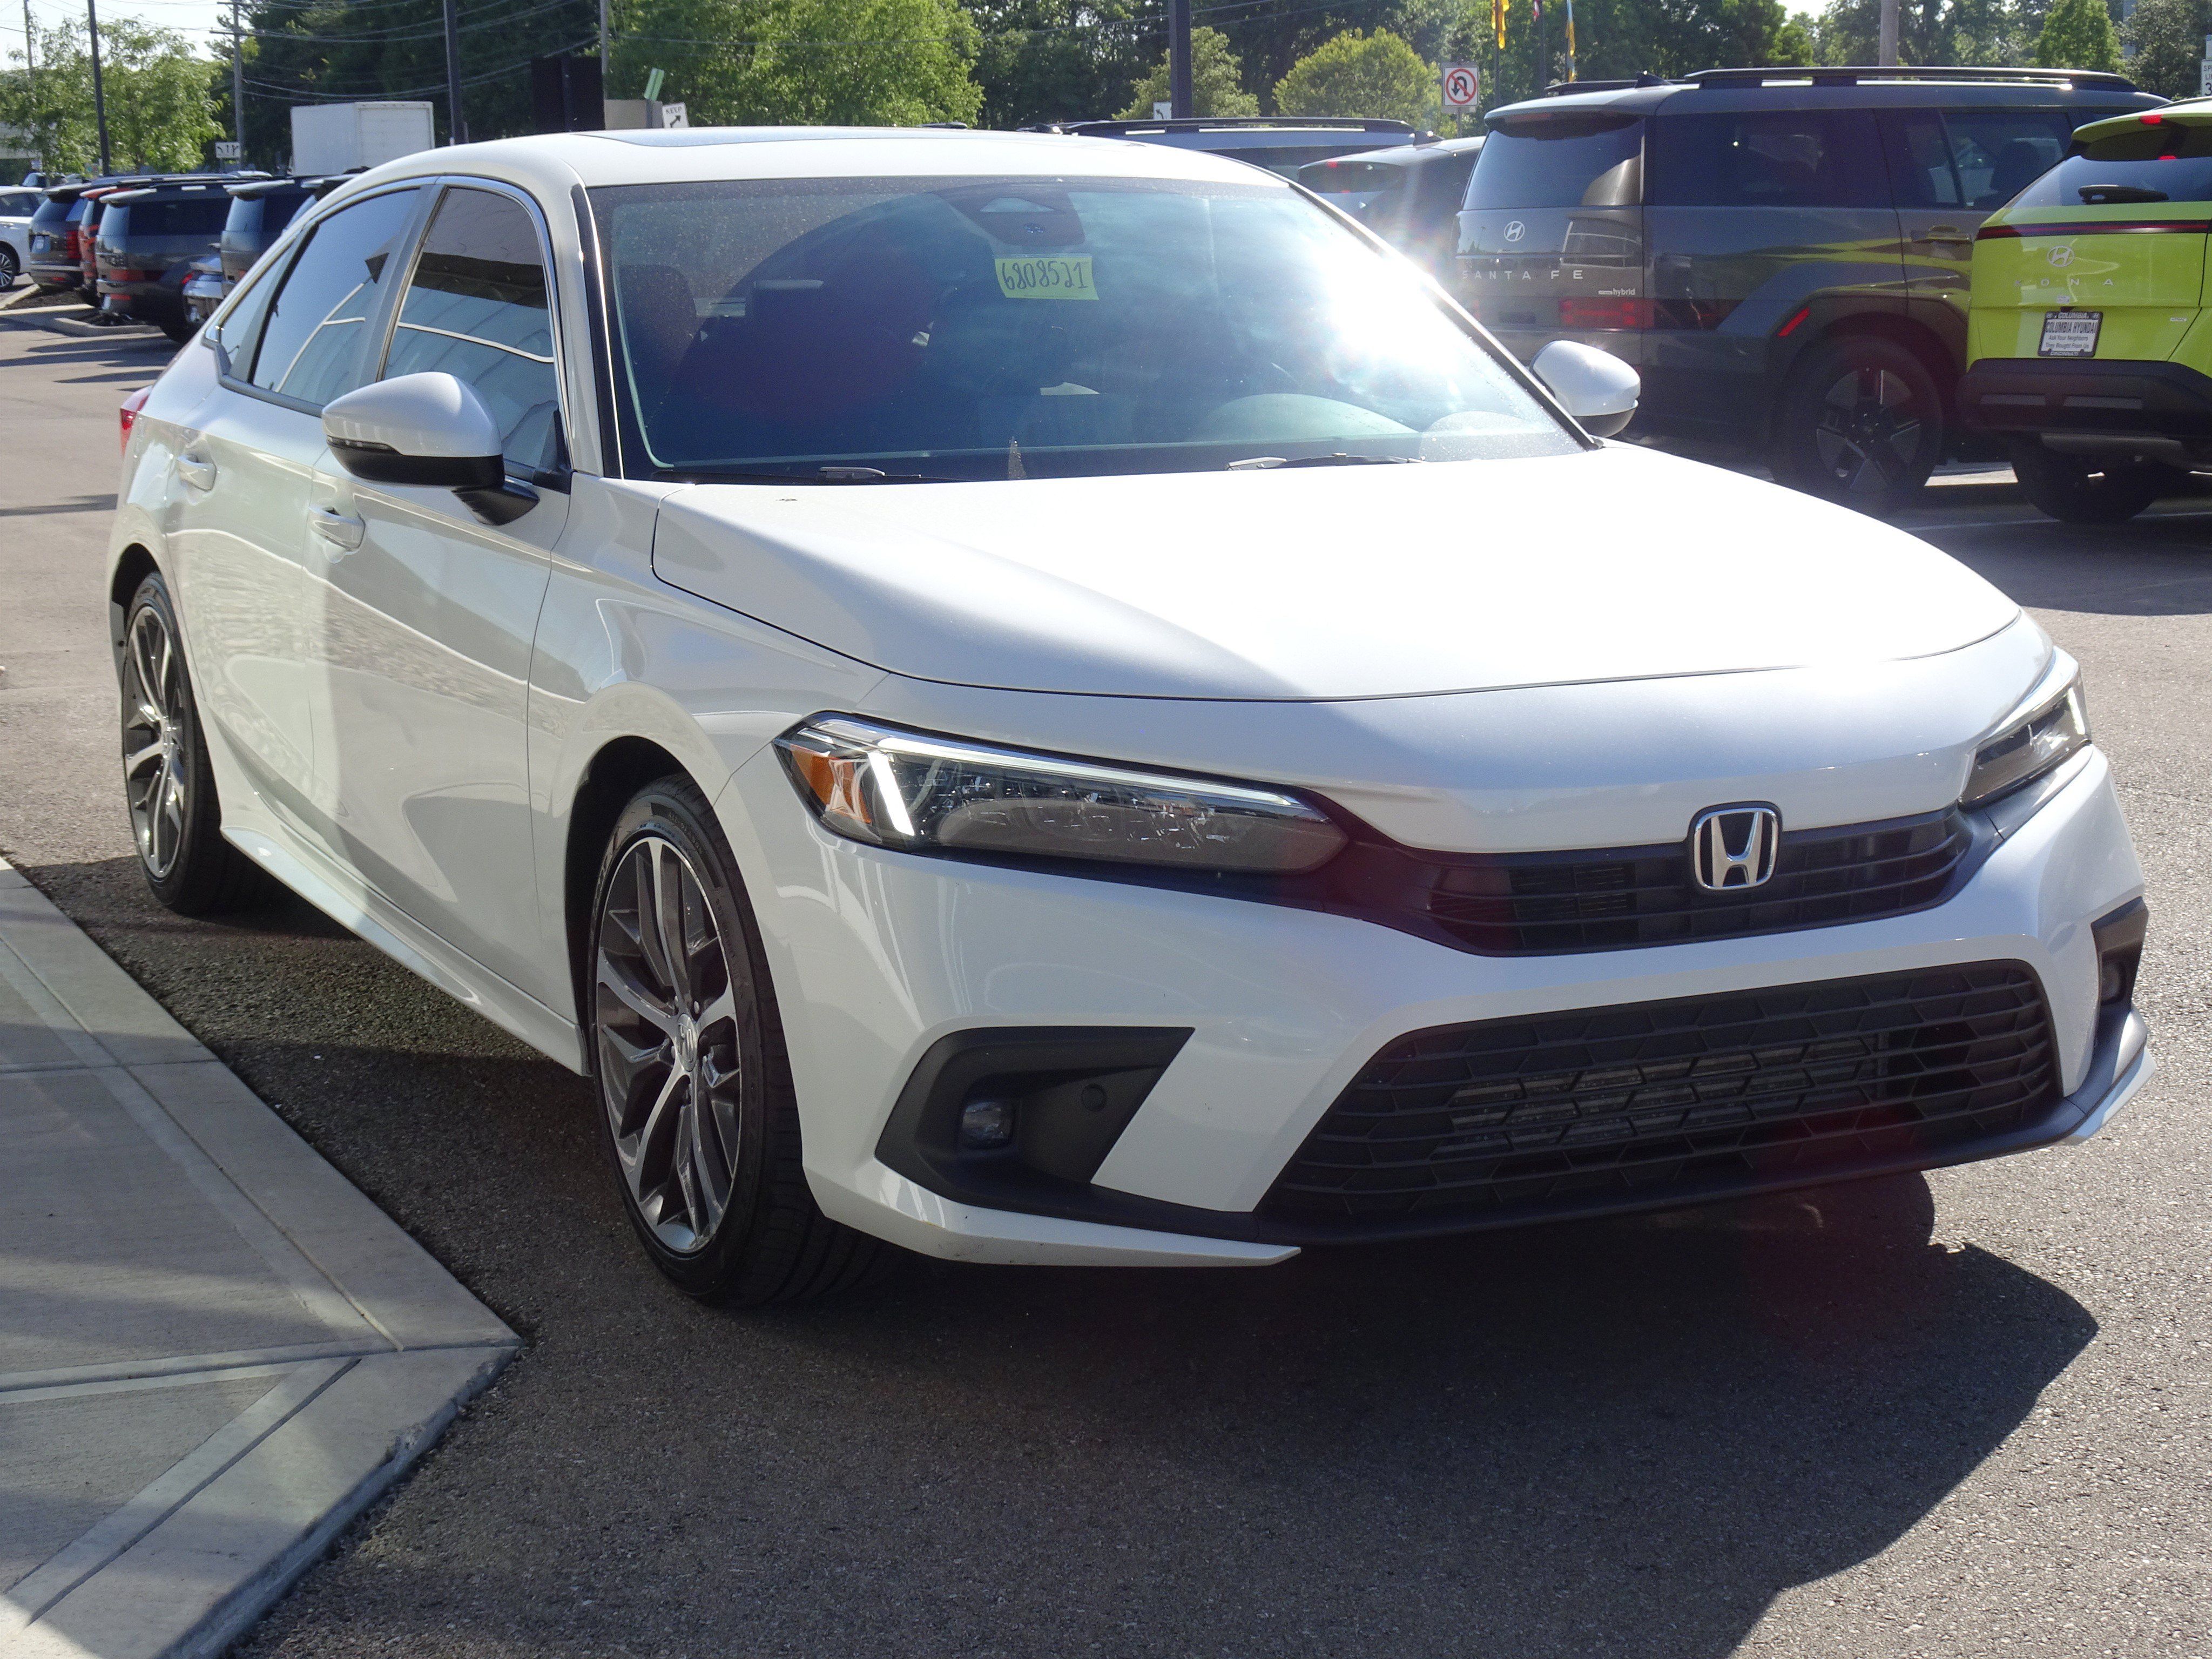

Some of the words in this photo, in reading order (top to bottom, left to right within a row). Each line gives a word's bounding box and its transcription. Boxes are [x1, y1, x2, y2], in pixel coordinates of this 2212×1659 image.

[1002, 260, 1088, 290] 6808521
[1462, 270, 1532, 280] SANTA
[1550, 269, 1583, 280] FE
[2014, 278, 2114, 286] KONA
[1613, 288, 1636, 296] hybrid
[2045, 321, 2073, 333] COLUMBIA
[2073, 321, 2098, 333] HYUNDAI
